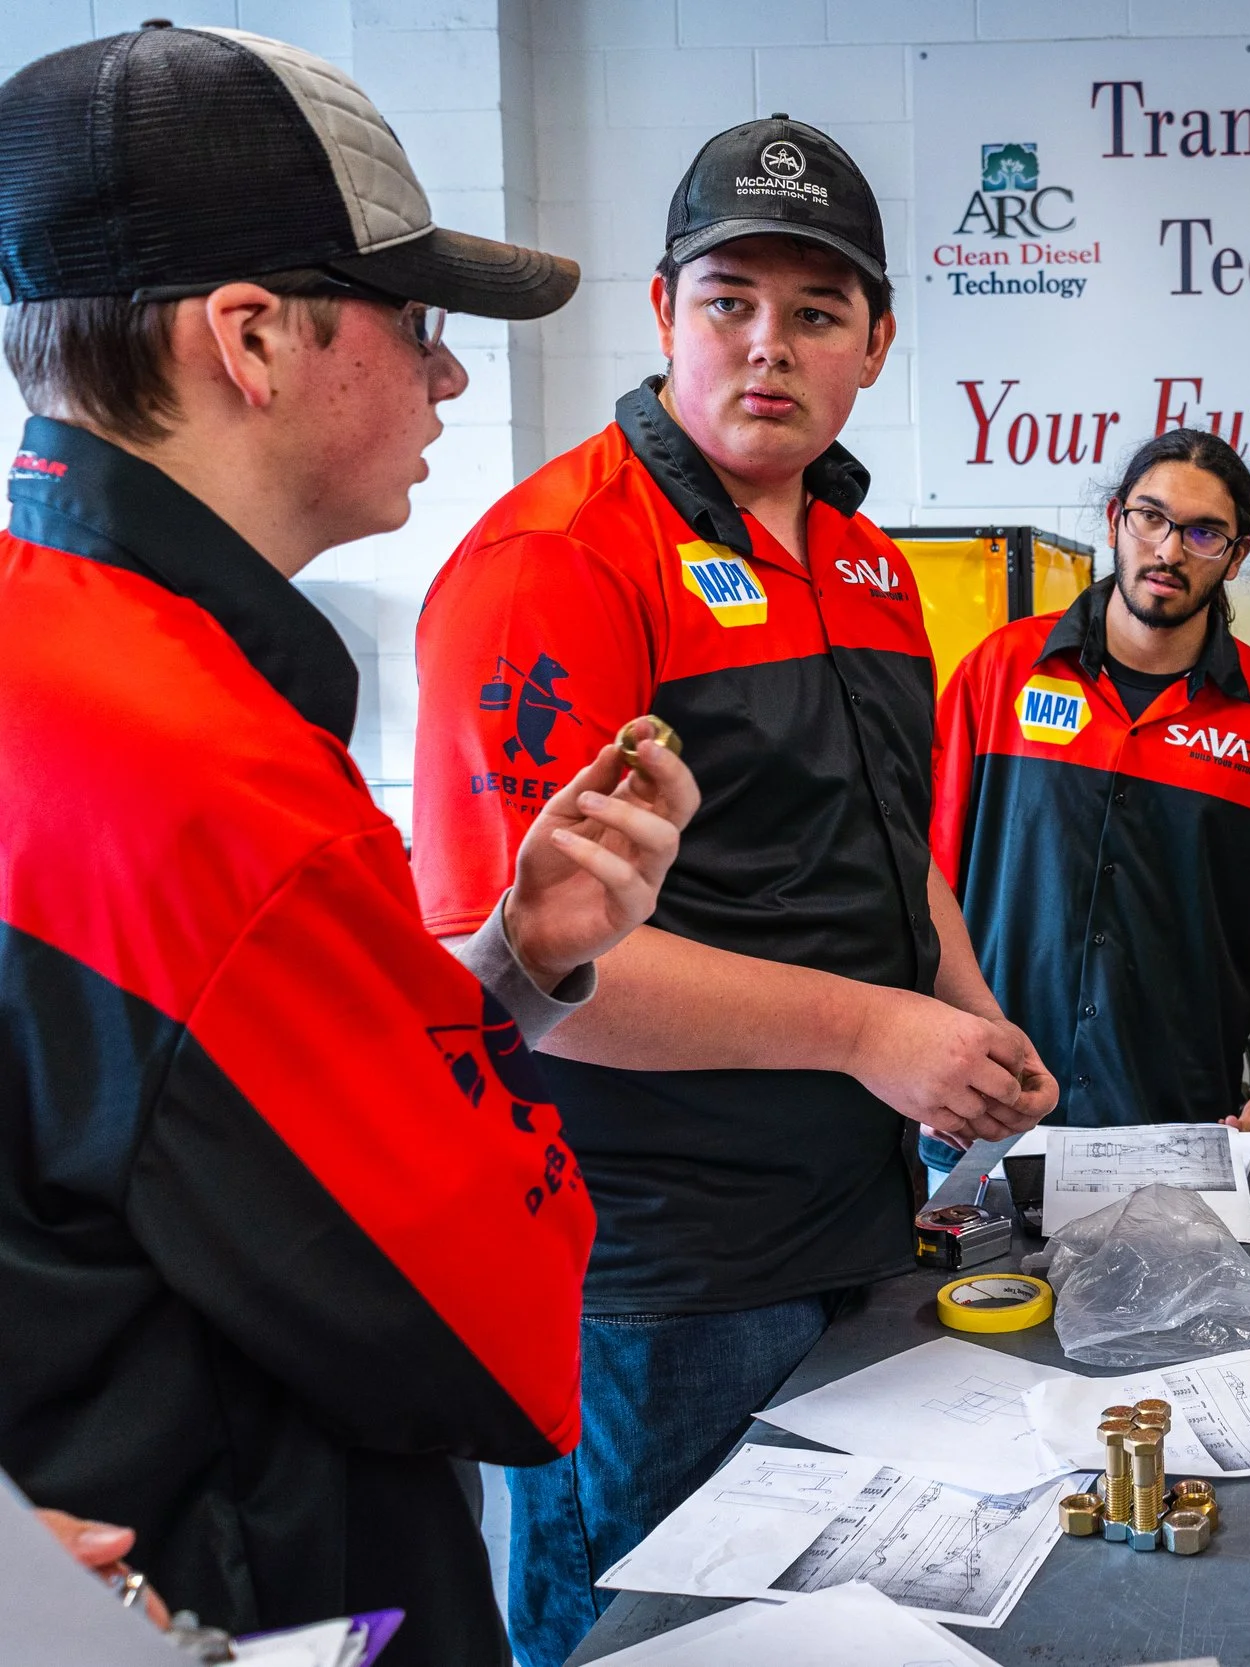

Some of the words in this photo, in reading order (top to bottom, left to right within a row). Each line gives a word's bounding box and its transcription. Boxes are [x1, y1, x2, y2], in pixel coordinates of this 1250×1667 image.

[735, 176, 828, 198] McCANDLESS
[953, 186, 1077, 239] ARC
[933, 244, 1010, 267] Clean
[1019, 241, 1102, 265] Diesel
[947, 270, 1088, 299] Technology
[956, 379, 1120, 466] Your
[689, 561, 760, 603] NAPA
[1025, 691, 1079, 730] NAPA
[1164, 724, 1249, 763] SAVA
[471, 772, 566, 801] DEBEE
